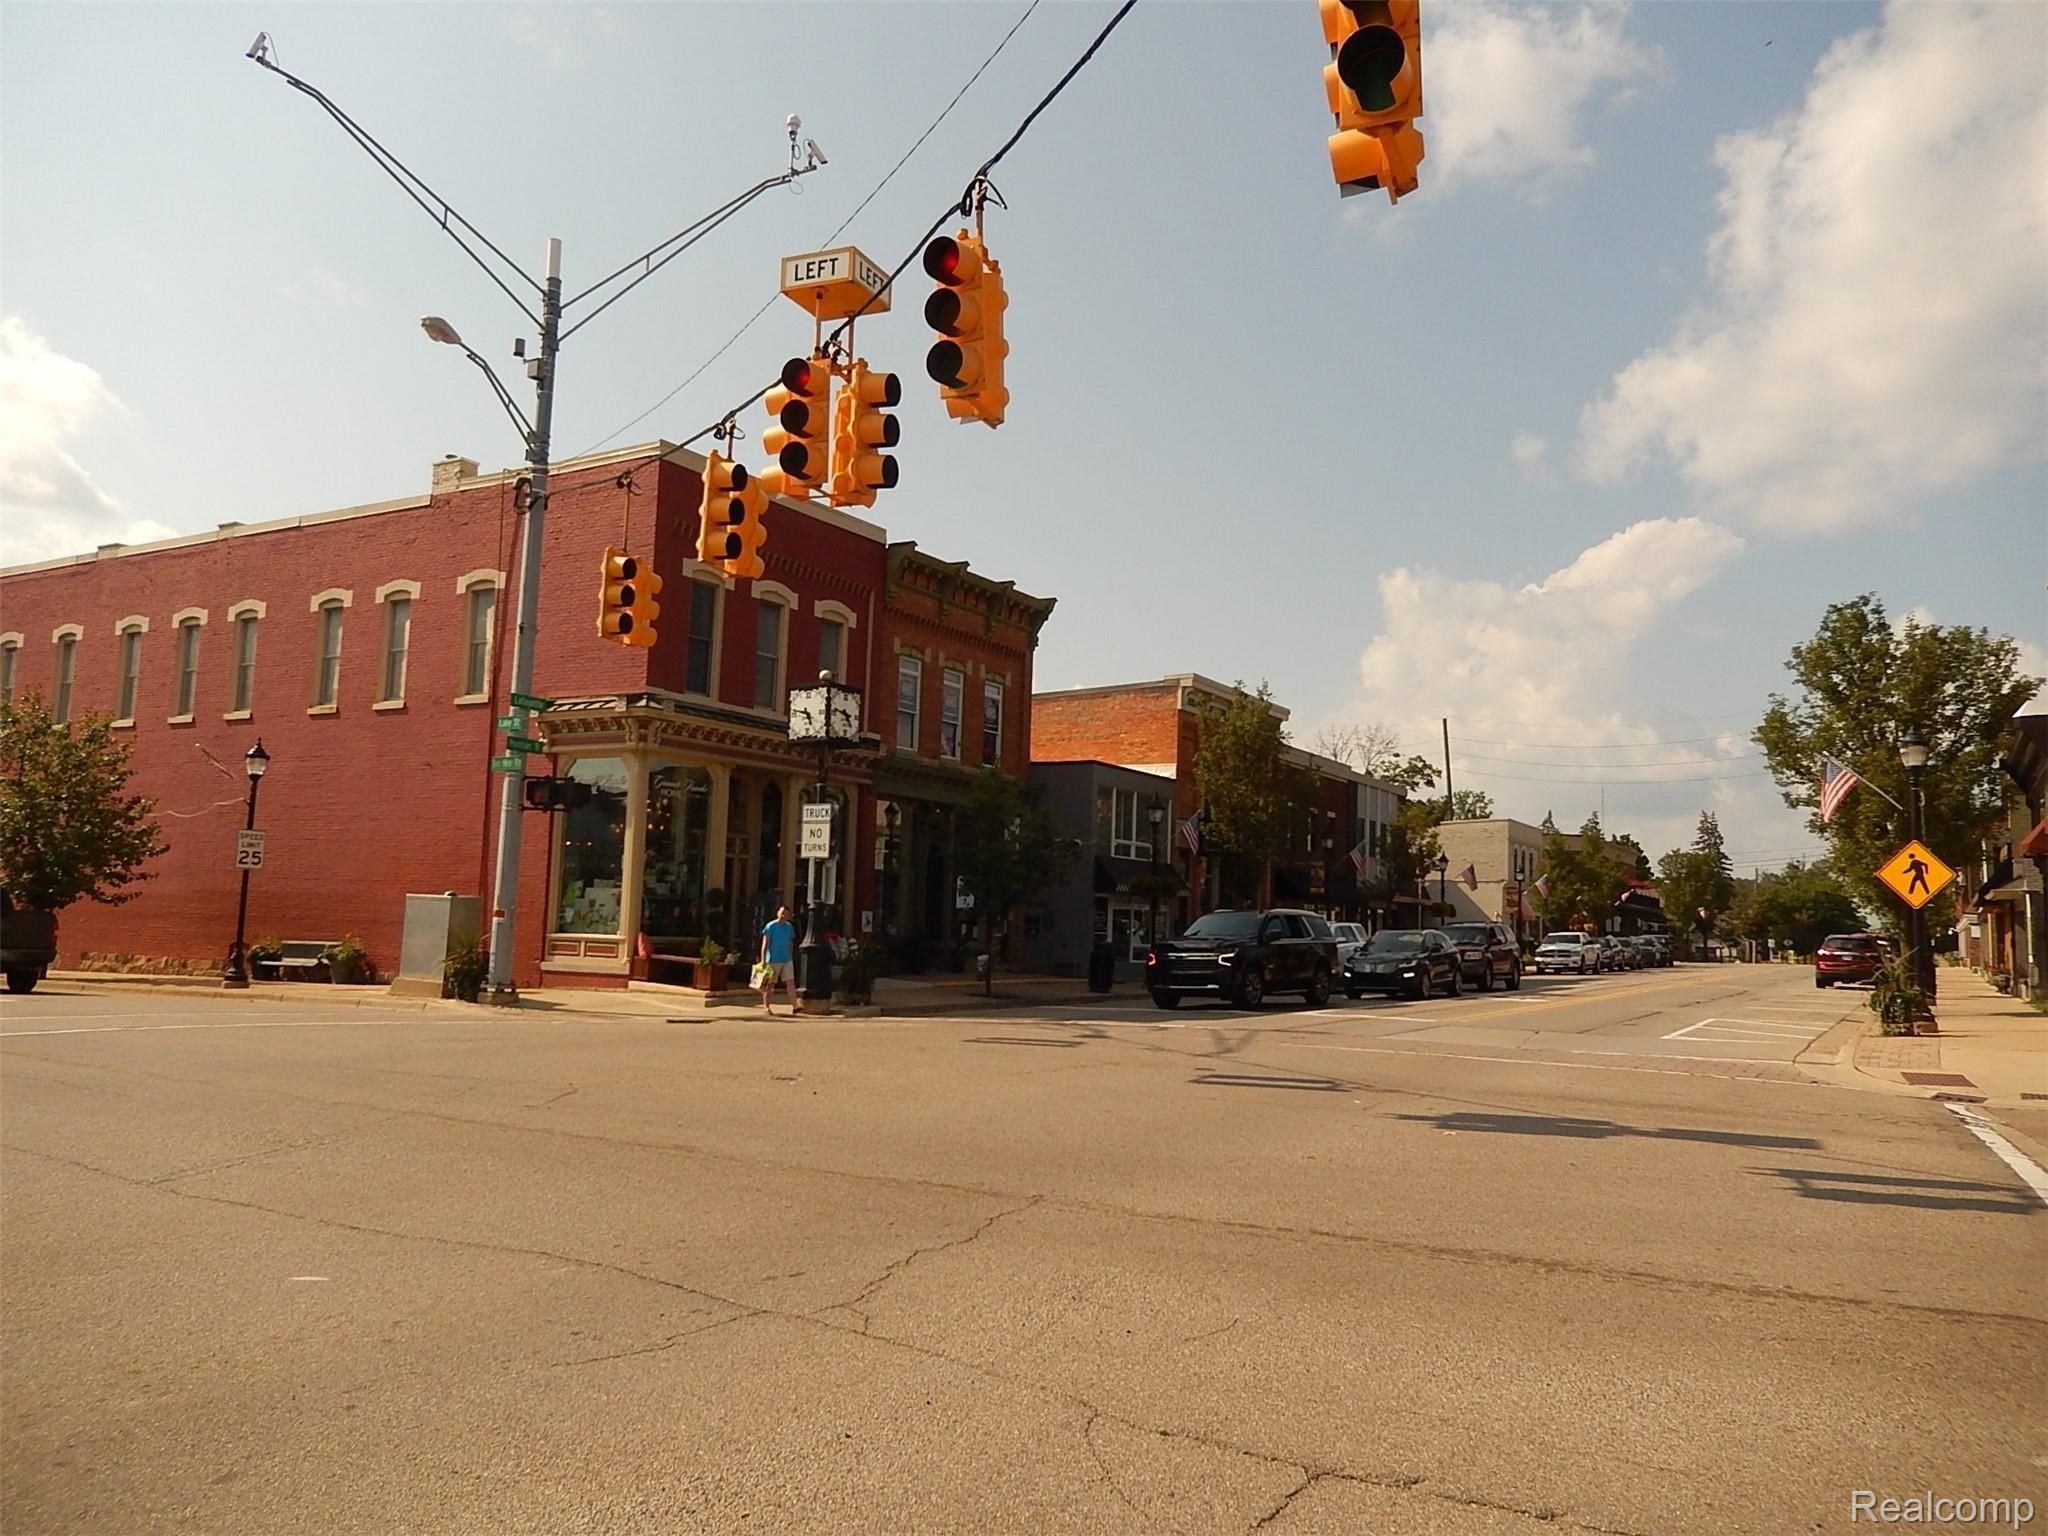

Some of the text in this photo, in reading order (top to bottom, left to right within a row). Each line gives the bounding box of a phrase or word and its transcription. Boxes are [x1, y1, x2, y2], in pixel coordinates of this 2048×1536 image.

[794, 258, 839, 282] LEFT
[859, 261, 885, 290] LEFT
[806, 807, 831, 818] TRUCK
[240, 833, 264, 841] SPEED
[810, 828, 823, 839] NO
[241, 841, 262, 849] LIMIT
[804, 843, 828, 852] TURNS
[238, 850, 262, 866] 25
